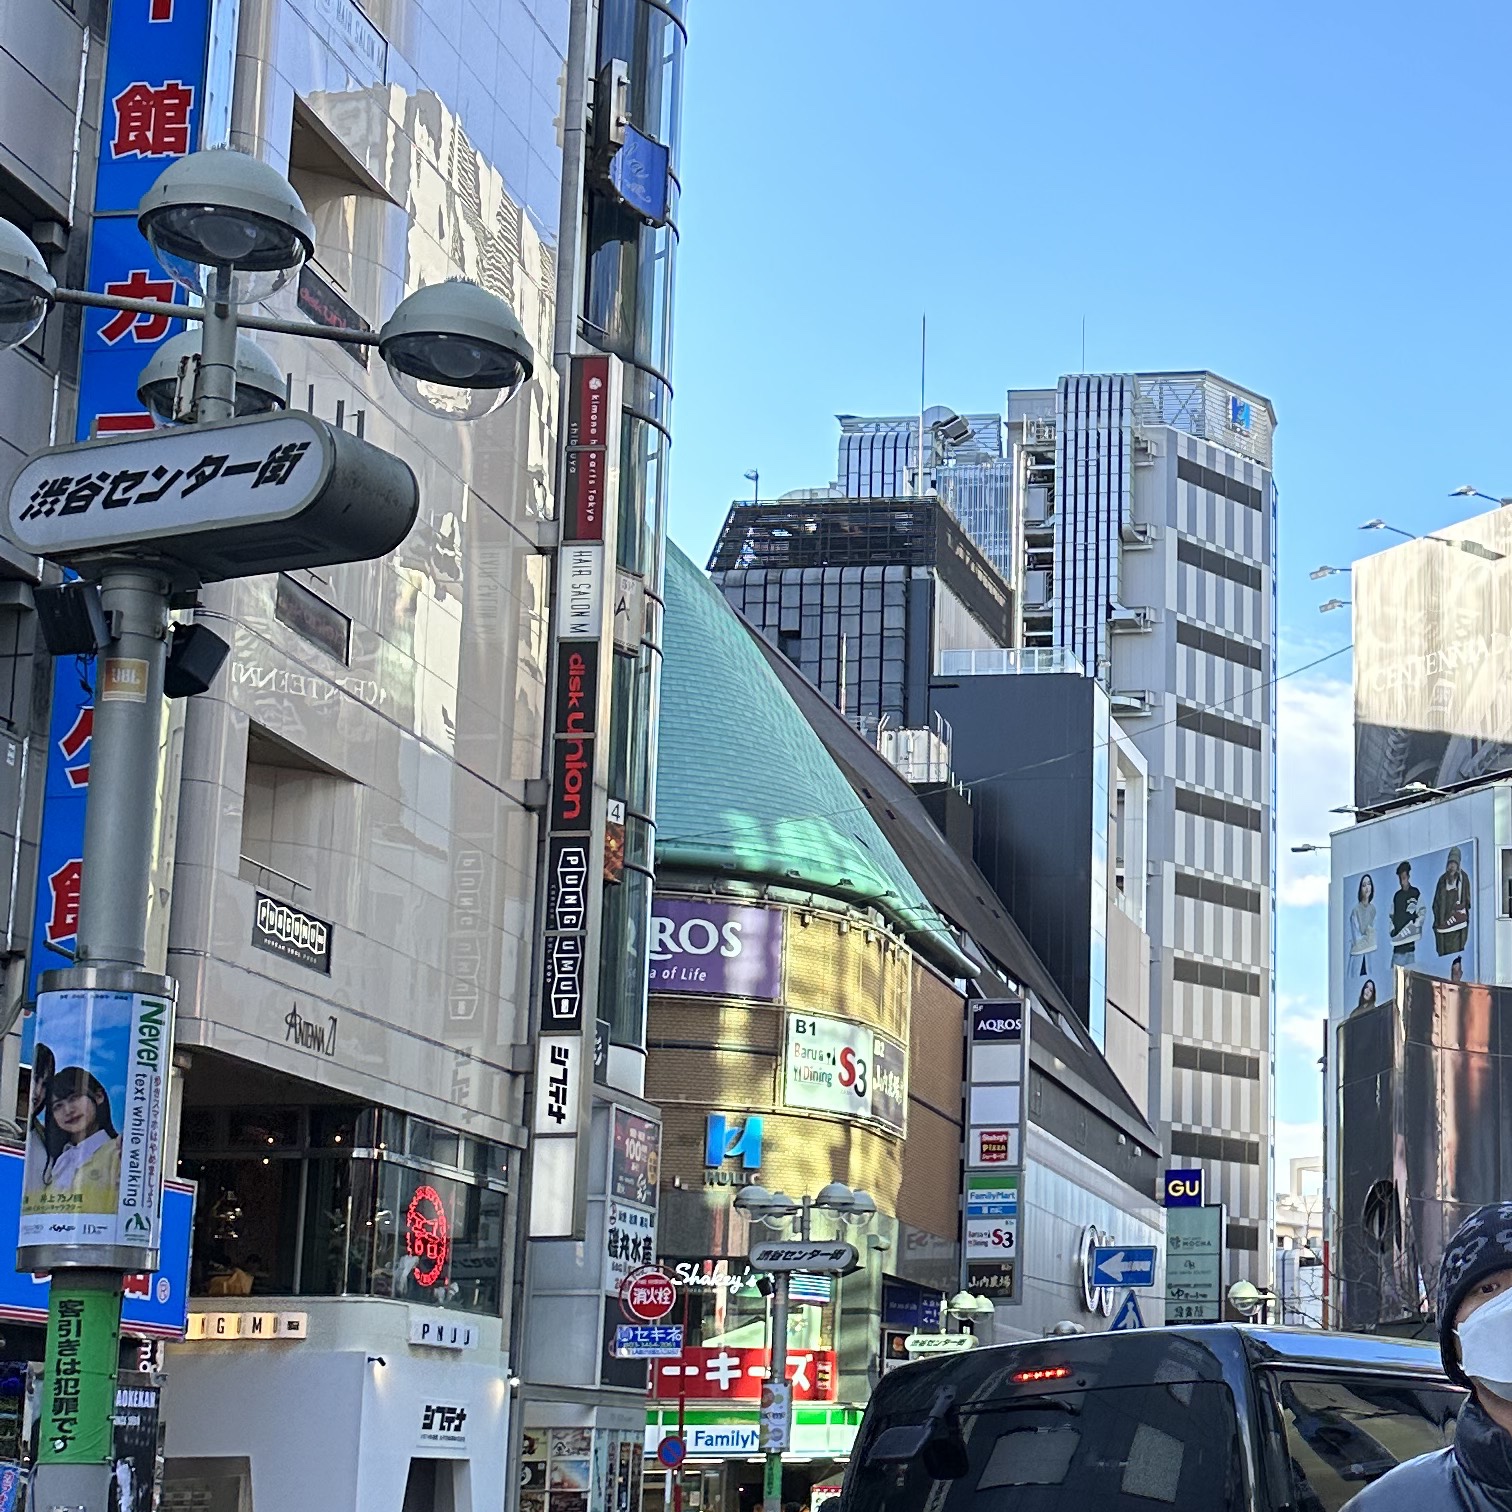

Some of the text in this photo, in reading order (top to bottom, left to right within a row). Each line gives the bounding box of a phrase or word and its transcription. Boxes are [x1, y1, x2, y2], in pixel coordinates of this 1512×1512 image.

[112, 80, 195, 159] 館
[590, 394, 600, 435] kimono
[20, 441, 312, 521] 渋谷センター街
[586, 488, 597, 523] Tokyo
[570, 550, 593, 635] HAIR SALON M
[563, 651, 589, 821] disk union
[611, 803, 621, 822] 4
[559, 854, 581, 991] PUNGUMU
[649, 916, 744, 960] ROS
[662, 967, 677, 980] of
[681, 967, 707, 982] Life
[795, 1019, 817, 1037] B1
[977, 1018, 1022, 1033] AQROS
[803, 1065, 833, 1088] Dining
[837, 1045, 868, 1098] S3
[123, 1000, 168, 1208] Never text while walking
[969, 1191, 1016, 1201] FamilyMart
[1167, 1179, 1200, 1197] GU
[756, 1249, 848, 1262] 渋谷センター街
[991, 1228, 1014, 1249] S3
[670, 1261, 757, 1294] Shakey's
[632, 1286, 673, 1306] 消火栓
[49, 1298, 85, 1454] 客引きは犯罪です
[661, 1351, 814, 1392] ーキーズ
